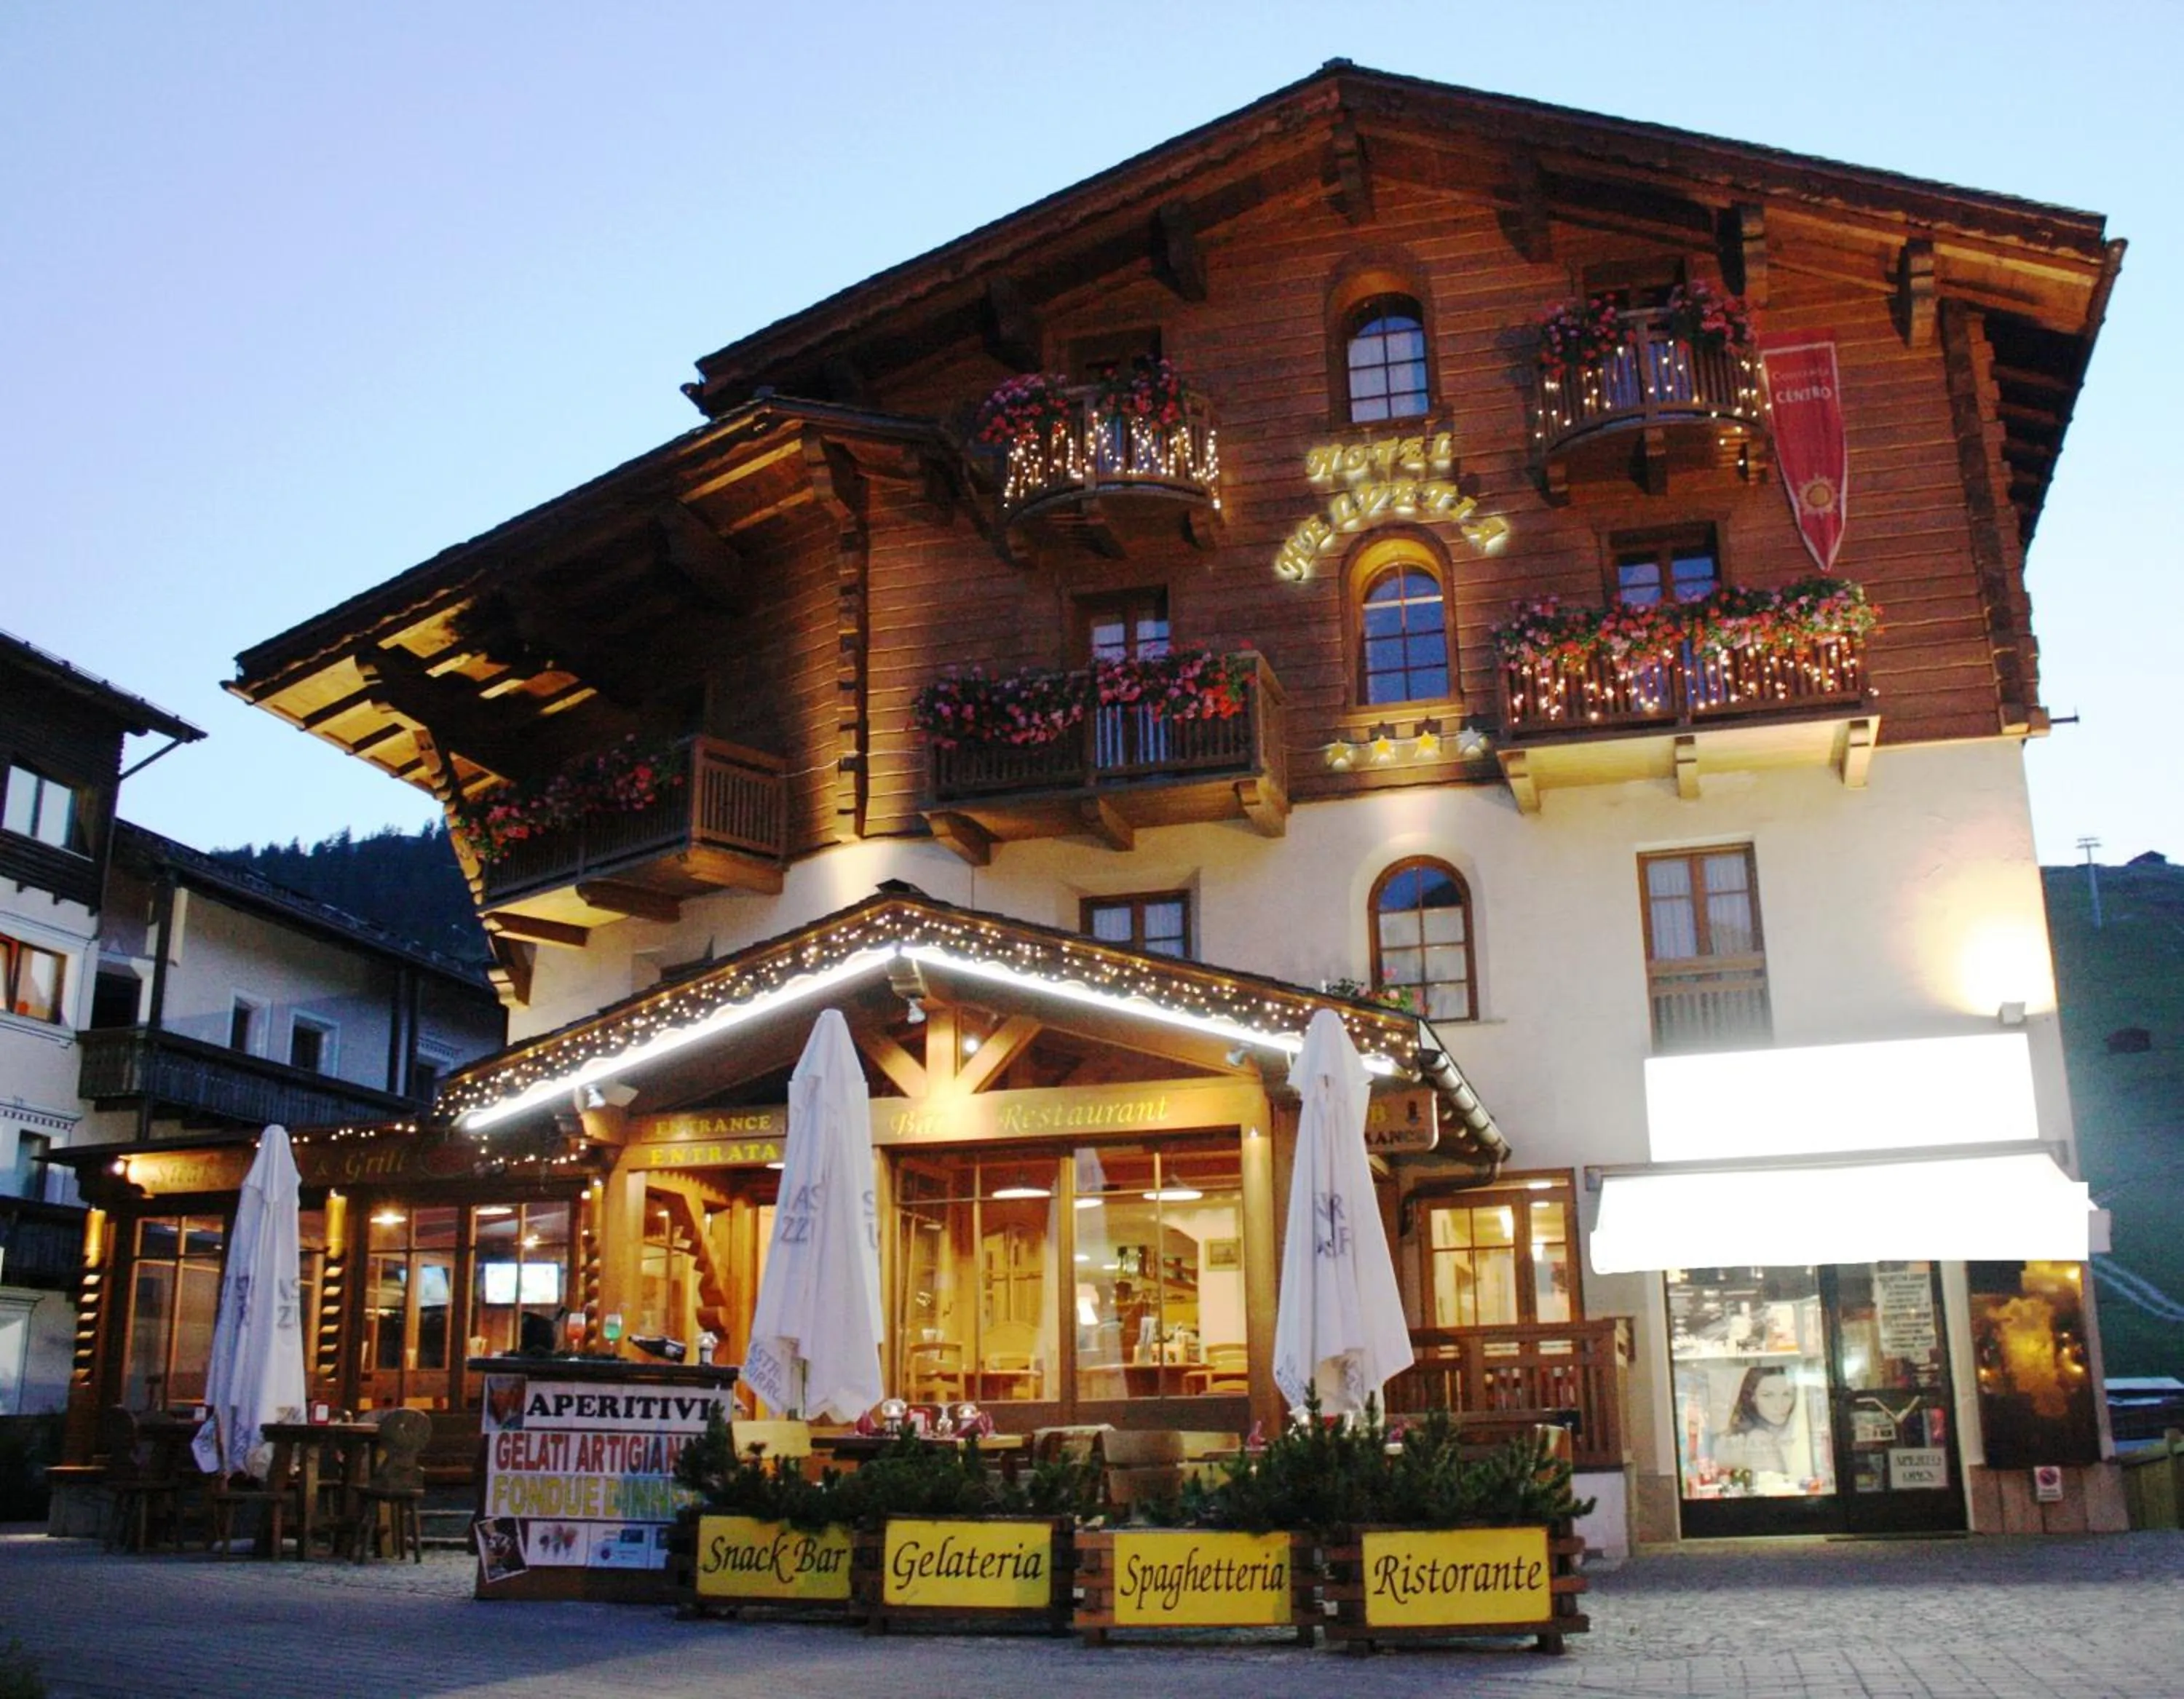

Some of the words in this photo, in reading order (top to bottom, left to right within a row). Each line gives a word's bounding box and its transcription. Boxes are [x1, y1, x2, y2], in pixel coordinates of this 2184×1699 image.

[1776, 386, 1832, 404] CENTRO
[1307, 432, 1452, 482] HOTEL
[656, 1115, 772, 1135] ENTRANCE
[999, 1095, 1169, 1135] Restaurant
[651, 1143, 779, 1165] ENTRATA
[527, 1393, 711, 1420] APERITIVI
[496, 1432, 569, 1471] GELATI
[575, 1434, 690, 1473] ARTIGIAN
[492, 1475, 598, 1516] FONDUE
[703, 1532, 794, 1583] Snack
[794, 1537, 847, 1572] Bar
[893, 1537, 1042, 1589] Gelateria
[1120, 1547, 1284, 1609] Spaghetteria
[1374, 1553, 1543, 1605] Ristorante
